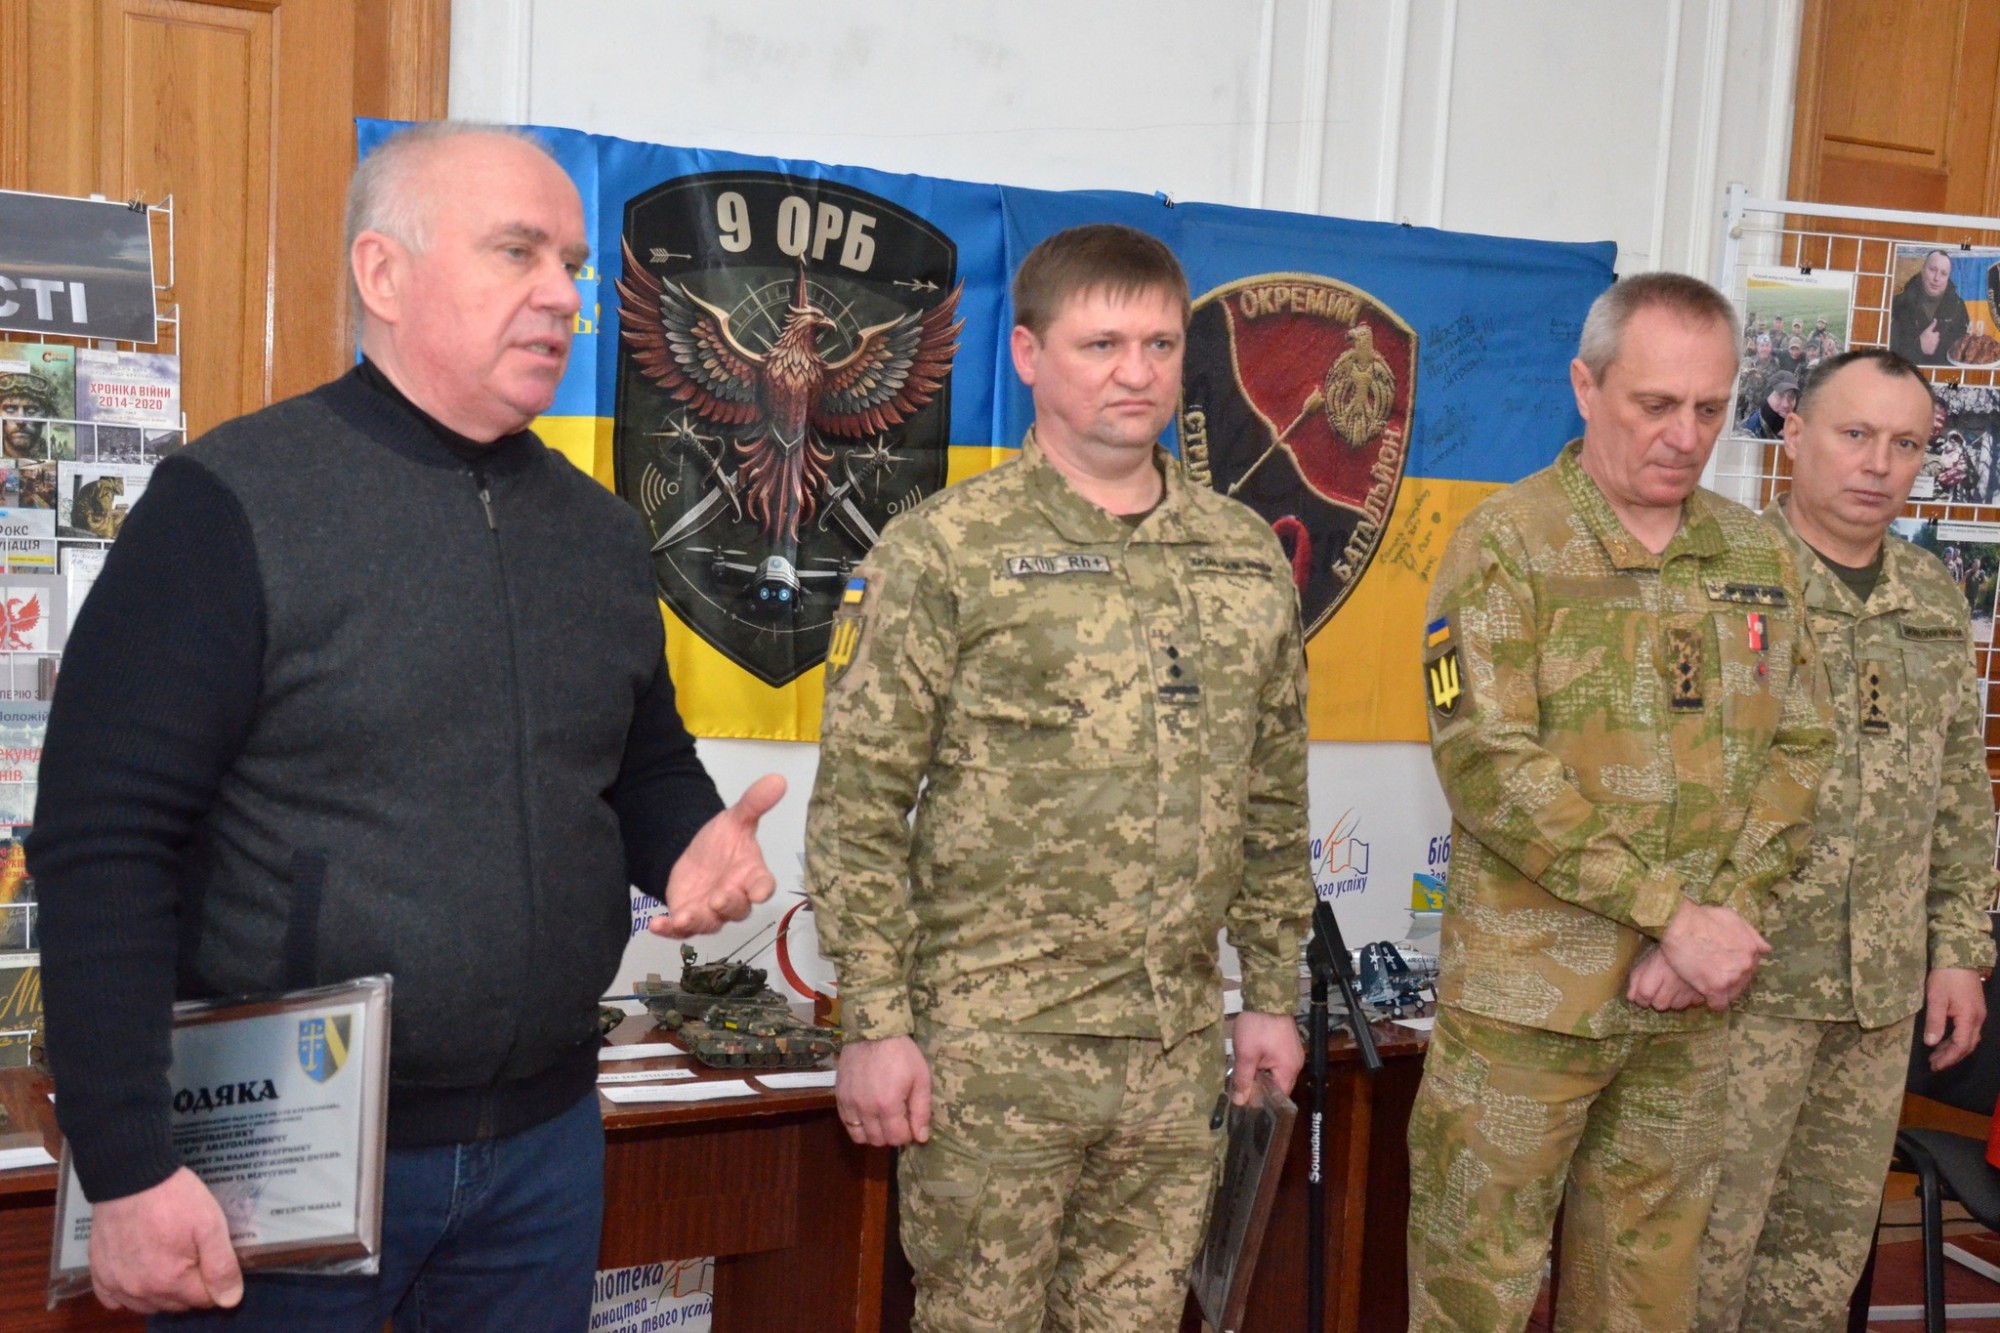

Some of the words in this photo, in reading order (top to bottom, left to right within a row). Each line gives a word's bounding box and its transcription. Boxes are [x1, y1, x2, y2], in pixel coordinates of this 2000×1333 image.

[716, 191, 752, 253] 9
[776, 195, 878, 273] ОРБ
[90, 383, 137, 396] ХРОНІКА
[139, 385, 171, 399] ВІЙНИ
[1332, 426, 1402, 580] БАТАЛЬЙОН
[1068, 556, 1102, 568] Rh+
[1336, 874, 1367, 898] успіху
[173, 1079, 280, 1115] ОДЯКА
[1308, 1111, 1323, 1184] Soundking
[591, 1297, 648, 1330] юнацтва
[642, 1308, 678, 1333] твого
